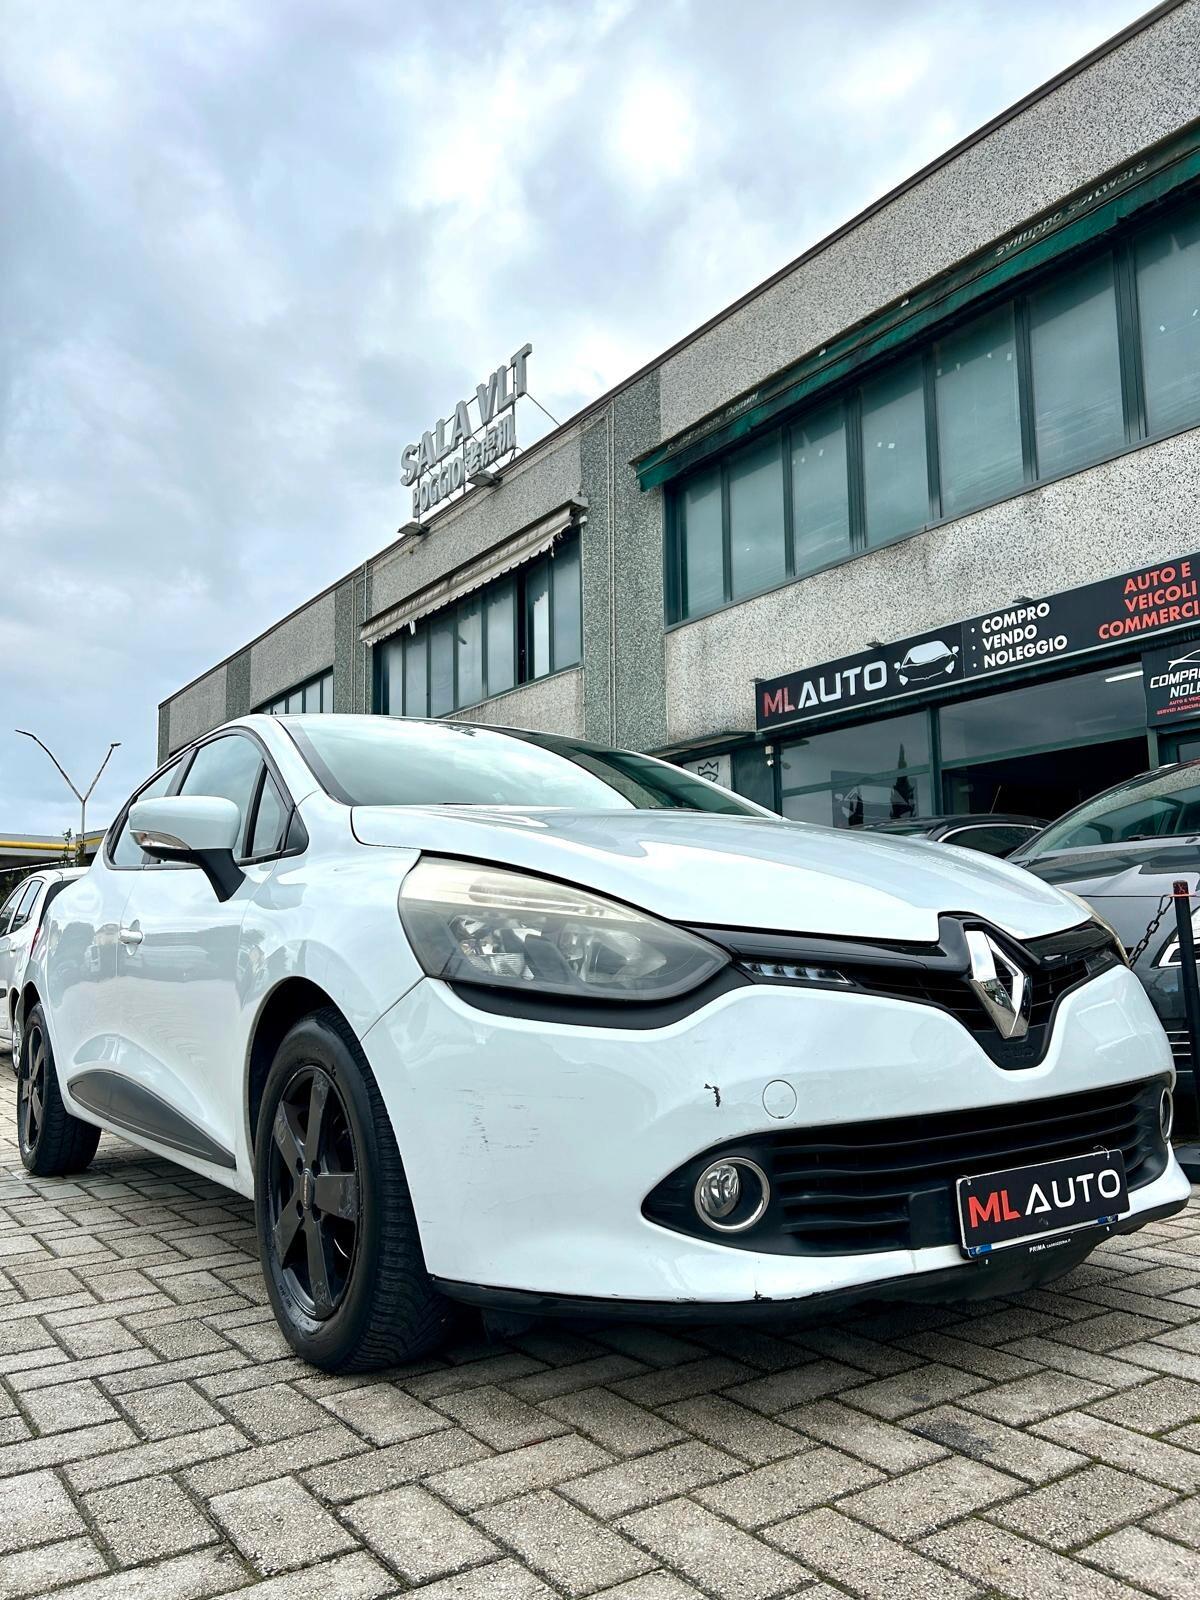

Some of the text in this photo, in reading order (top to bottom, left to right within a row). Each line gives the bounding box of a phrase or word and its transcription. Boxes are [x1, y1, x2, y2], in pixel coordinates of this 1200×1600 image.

[400, 342, 533, 487] SALA VLT
[412, 456, 466, 518] POGGIO
[1124, 561, 1192, 595] AUTO E
[1124, 580, 1198, 613] VEICOLI
[981, 602, 1051, 634] COMPRO
[1098, 600, 1200, 640] COMMERCI
[981, 624, 1038, 651] VENDO
[983, 634, 1068, 669] NOLEGGIO
[763, 660, 888, 718] ML AUTO
[1149, 667, 1200, 689] COMPR
[968, 1168, 1121, 1228] ML AUTO
